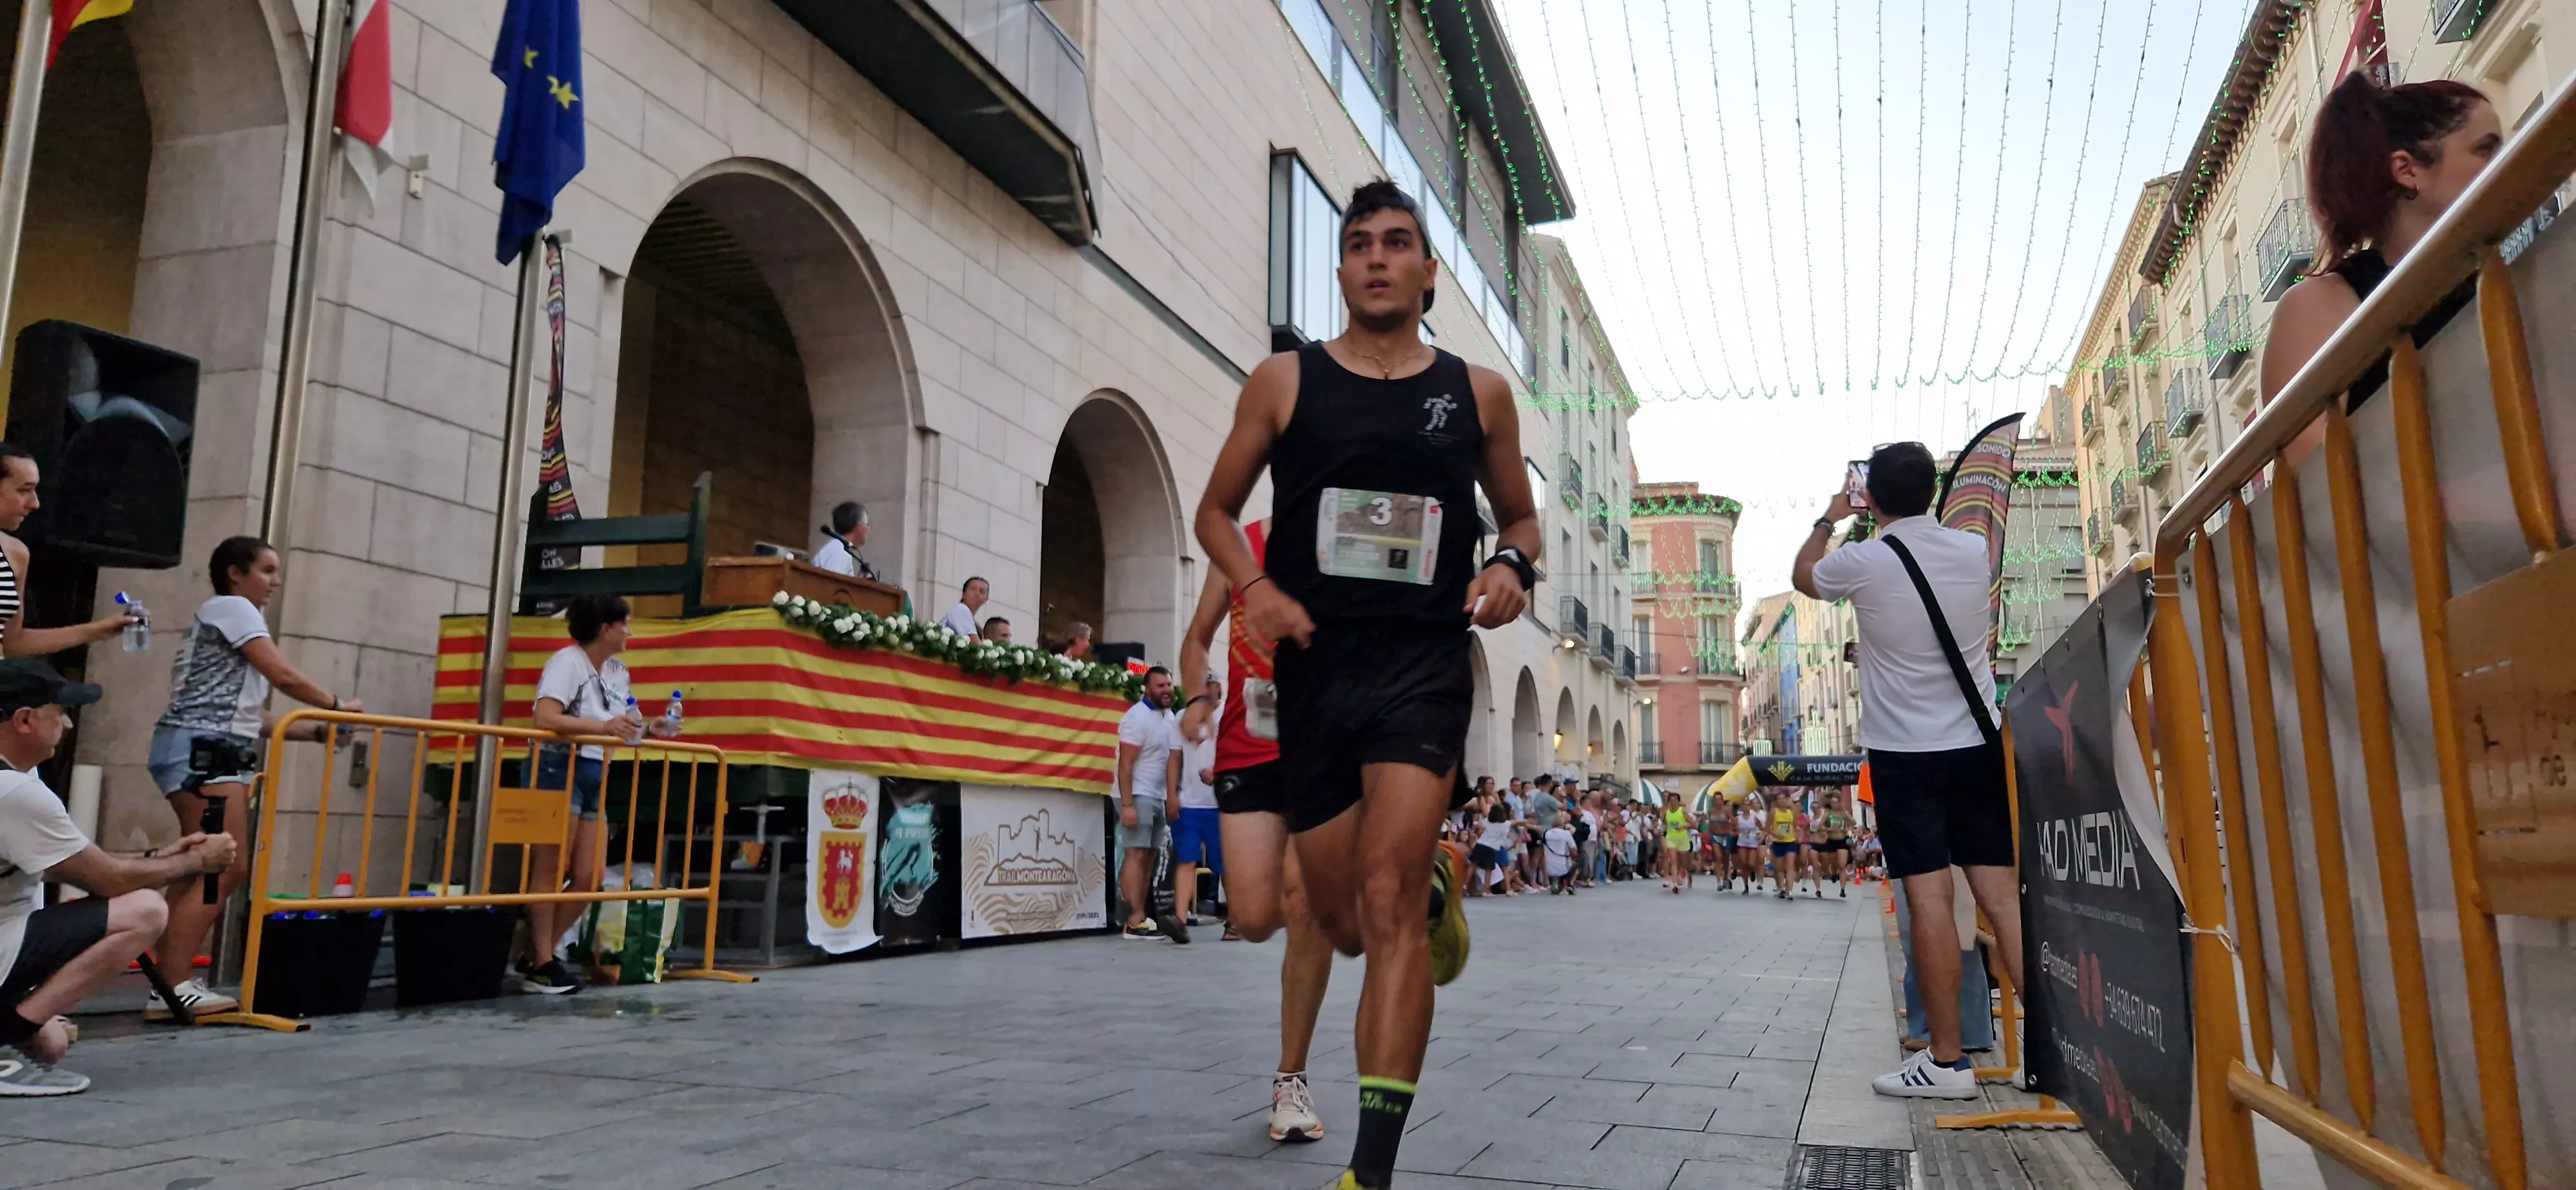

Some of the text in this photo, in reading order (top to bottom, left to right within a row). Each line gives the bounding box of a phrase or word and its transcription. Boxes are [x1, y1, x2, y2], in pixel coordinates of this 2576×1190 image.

[1976, 443, 2011, 457] SONIDO
[1368, 496, 1394, 527] 3
[2070, 809, 2141, 891] MEDIA
